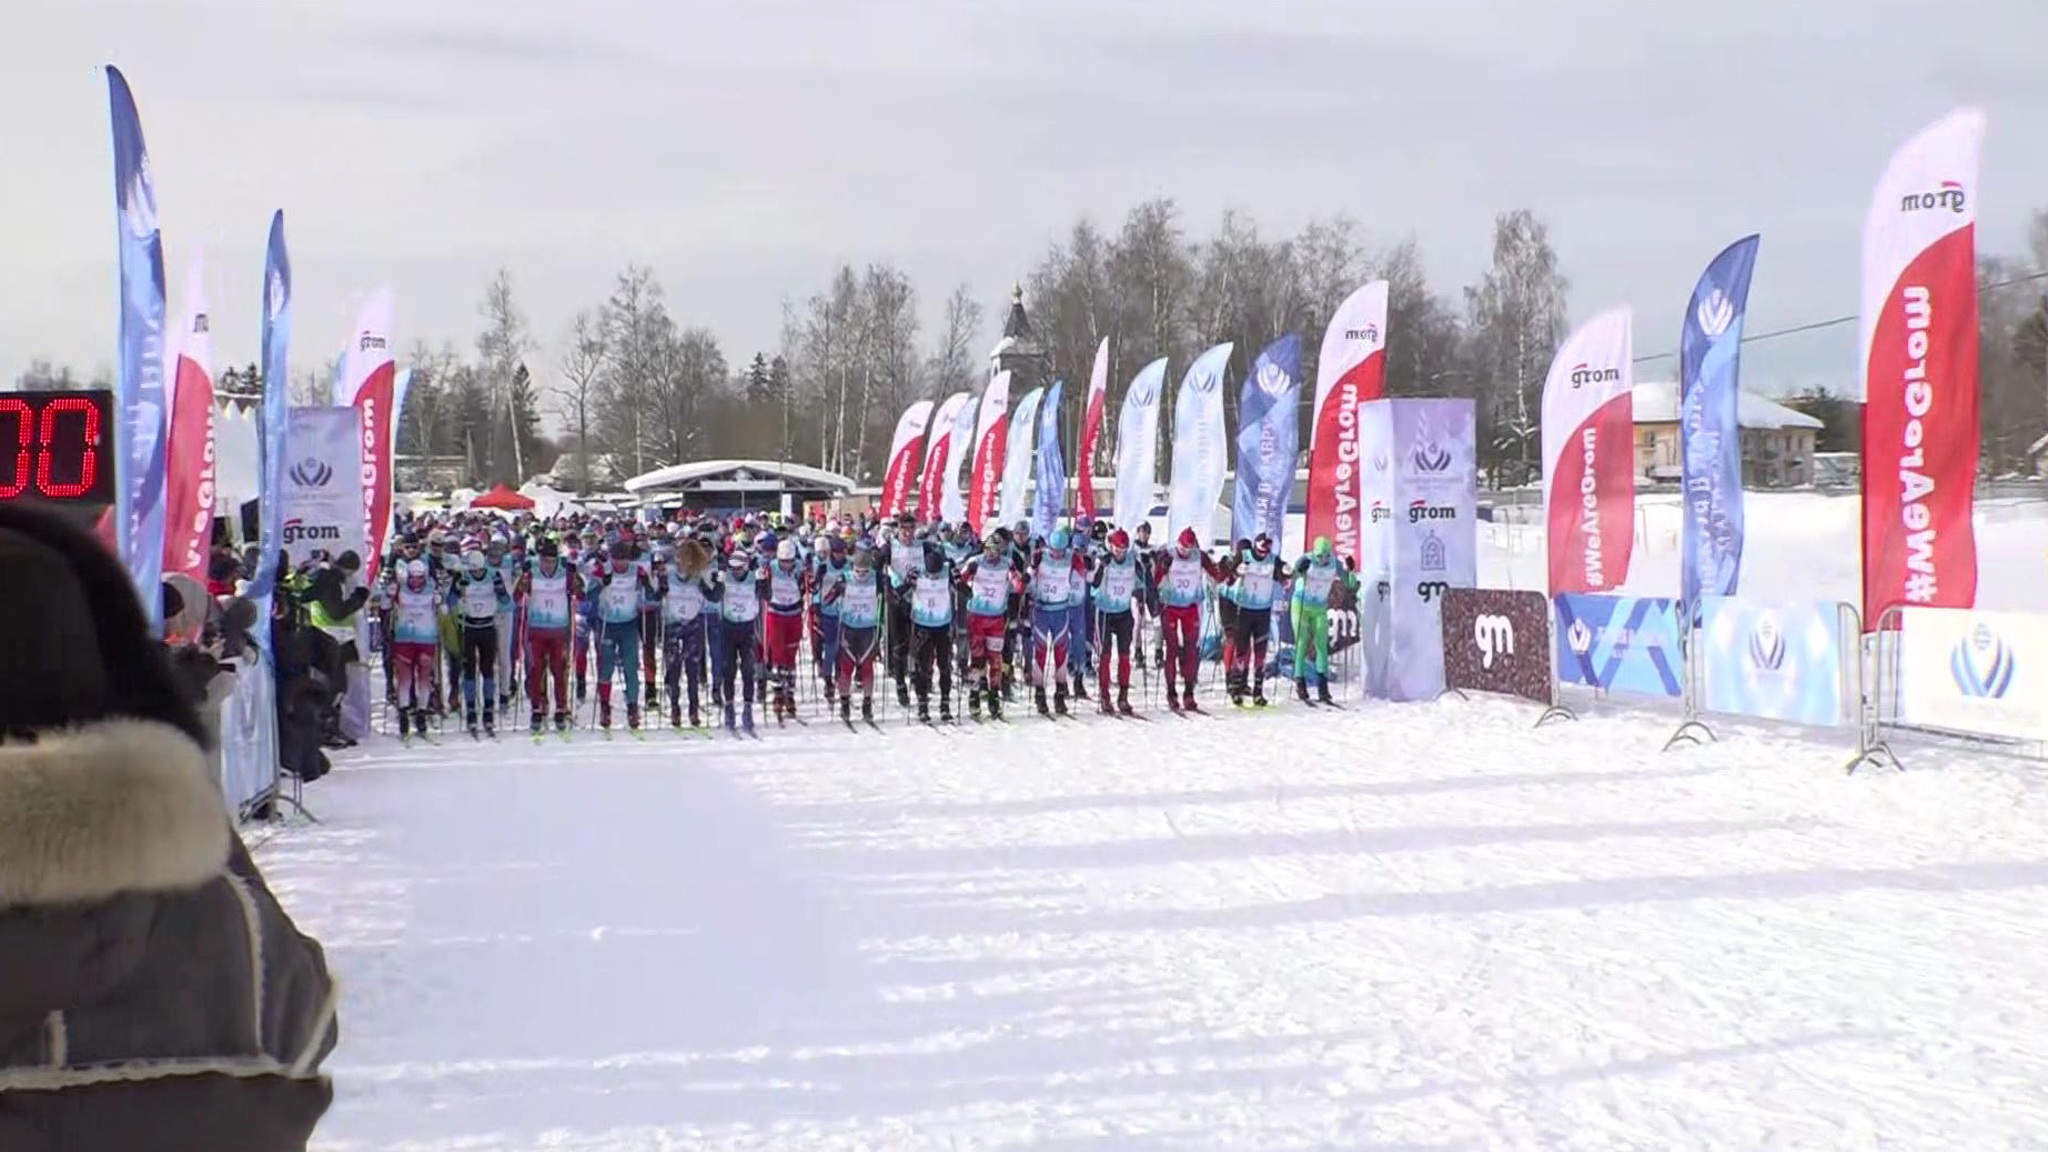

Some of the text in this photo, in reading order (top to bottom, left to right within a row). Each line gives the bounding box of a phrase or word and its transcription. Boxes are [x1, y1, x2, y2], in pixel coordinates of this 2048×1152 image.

[361, 331, 386, 350] grom
[1571, 363, 1620, 388] grom
[1409, 501, 1456, 522] grom
[1581, 427, 1604, 586] #WeAreGrom
[283, 519, 340, 544] grom
[1475, 614, 1514, 669] gm
